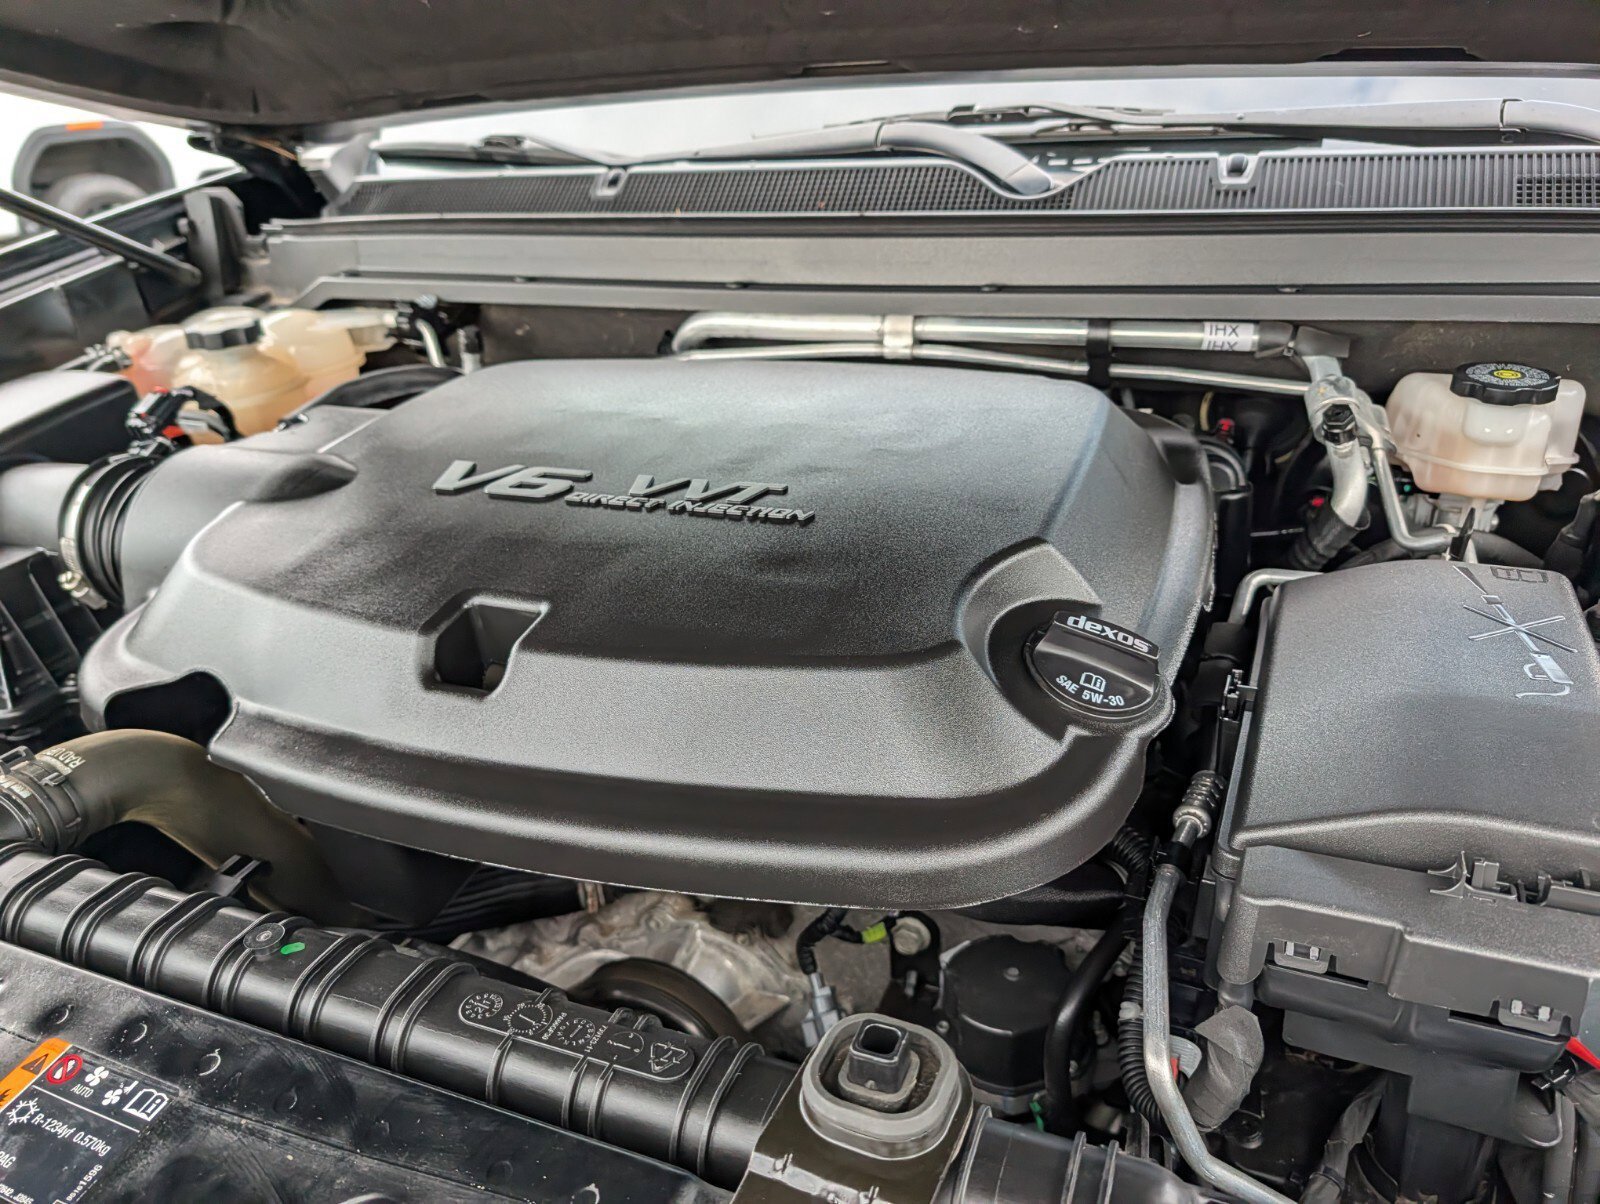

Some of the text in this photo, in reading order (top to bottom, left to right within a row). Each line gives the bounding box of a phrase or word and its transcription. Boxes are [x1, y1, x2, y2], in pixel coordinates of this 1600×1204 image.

[1209, 324, 1240, 337] IHX
[432, 460, 788, 505] V6 VVT
[565, 491, 815, 524] DIRECT INJECTION
[1066, 615, 1150, 653] dexos
[1056, 675, 1125, 706] SAE 5W-30
[70, 1083, 95, 1098] AUTO
[31, 1114, 112, 1157] R-1234yf 0.570kg
